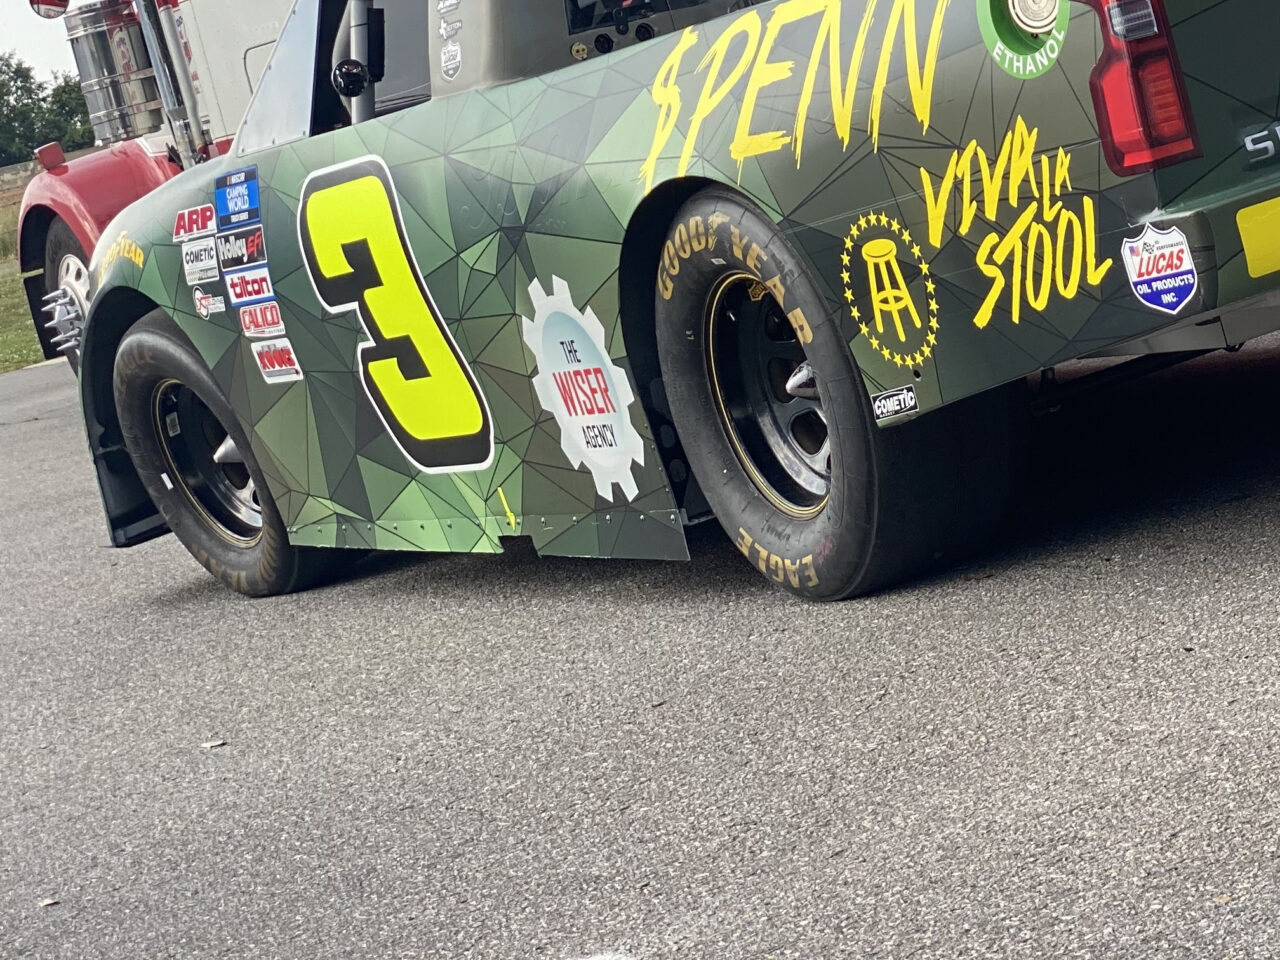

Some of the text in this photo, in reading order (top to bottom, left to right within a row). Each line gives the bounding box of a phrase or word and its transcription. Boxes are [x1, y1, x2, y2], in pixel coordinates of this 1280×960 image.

[992, 28, 1065, 76] ETHANOL
[226, 184, 249, 200] CAMPING
[920, 114, 1072, 248] VIVA LA
[227, 196, 250, 213] WORLD
[174, 205, 214, 237] ARP
[185, 247, 215, 265] COMETIC
[217, 235, 249, 263] Holley
[973, 195, 1113, 330] STOOL
[1137, 248, 1185, 279] LUCAS
[230, 275, 271, 300] tilton
[1137, 274, 1195, 295] OIL PRODUCTS
[1161, 292, 1179, 304] INC.
[241, 304, 281, 331] CALICO
[301, 168, 488, 452] 3
[560, 340, 582, 364] THE
[552, 367, 617, 417] WISER
[874, 389, 916, 416] COMETIC
[581, 424, 618, 448] AGENCY
[737, 527, 820, 588] EAGLE
